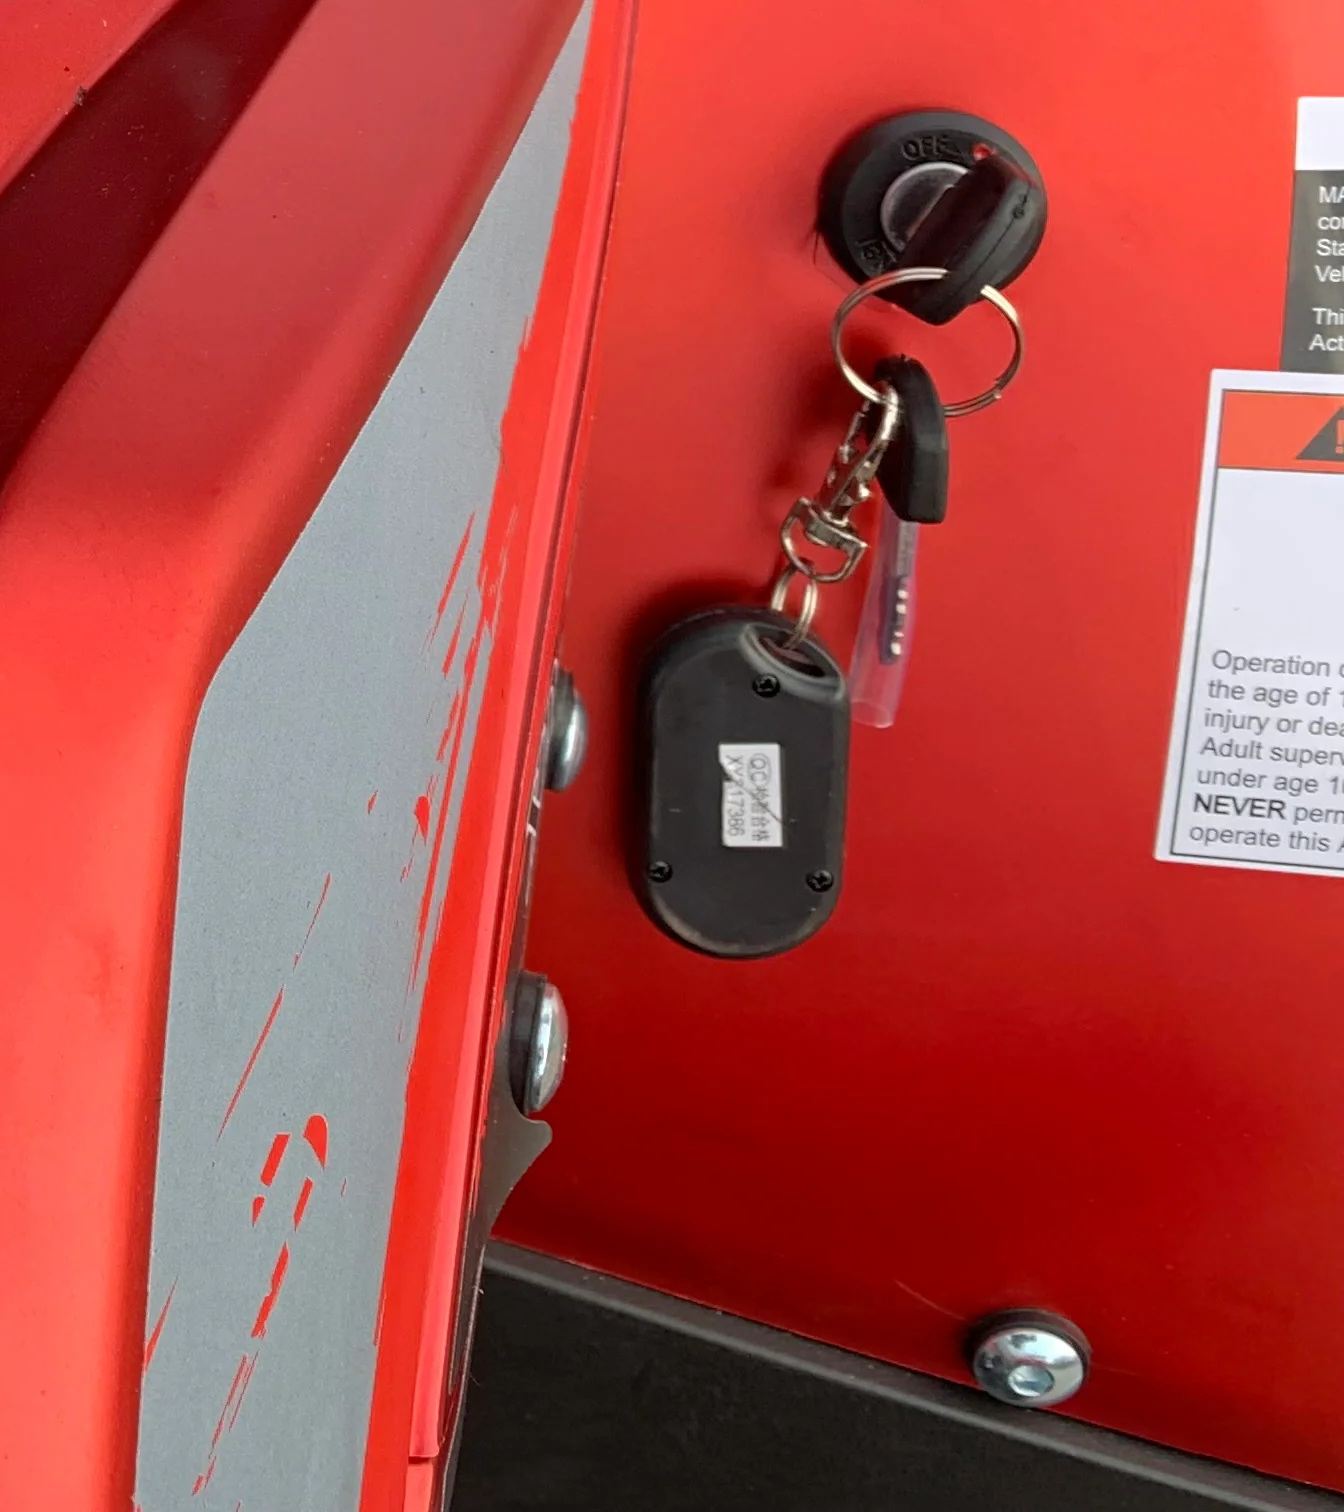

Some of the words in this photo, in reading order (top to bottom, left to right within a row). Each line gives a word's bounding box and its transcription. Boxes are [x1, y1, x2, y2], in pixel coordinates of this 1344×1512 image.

[1317, 216, 1344, 231] co
[1314, 264, 1344, 283] Ve
[1308, 333, 1344, 351] Act
[1211, 649, 1330, 677] Operation
[1207, 679, 1246, 700] the
[1252, 687, 1298, 708] age
[1305, 686, 1332, 707] of
[1203, 707, 1270, 737] injury
[1276, 717, 1302, 733] or
[1200, 737, 1264, 760] Adult
[1269, 744, 1344, 768] super
[750, 757, 767, 782] QC
[1197, 768, 1267, 789] under
[1273, 775, 1318, 797] age
[1330, 776, 1344, 795] 1
[1193, 792, 1286, 820] NEVER
[1189, 826, 1281, 847] operate
[1288, 830, 1330, 852] this
